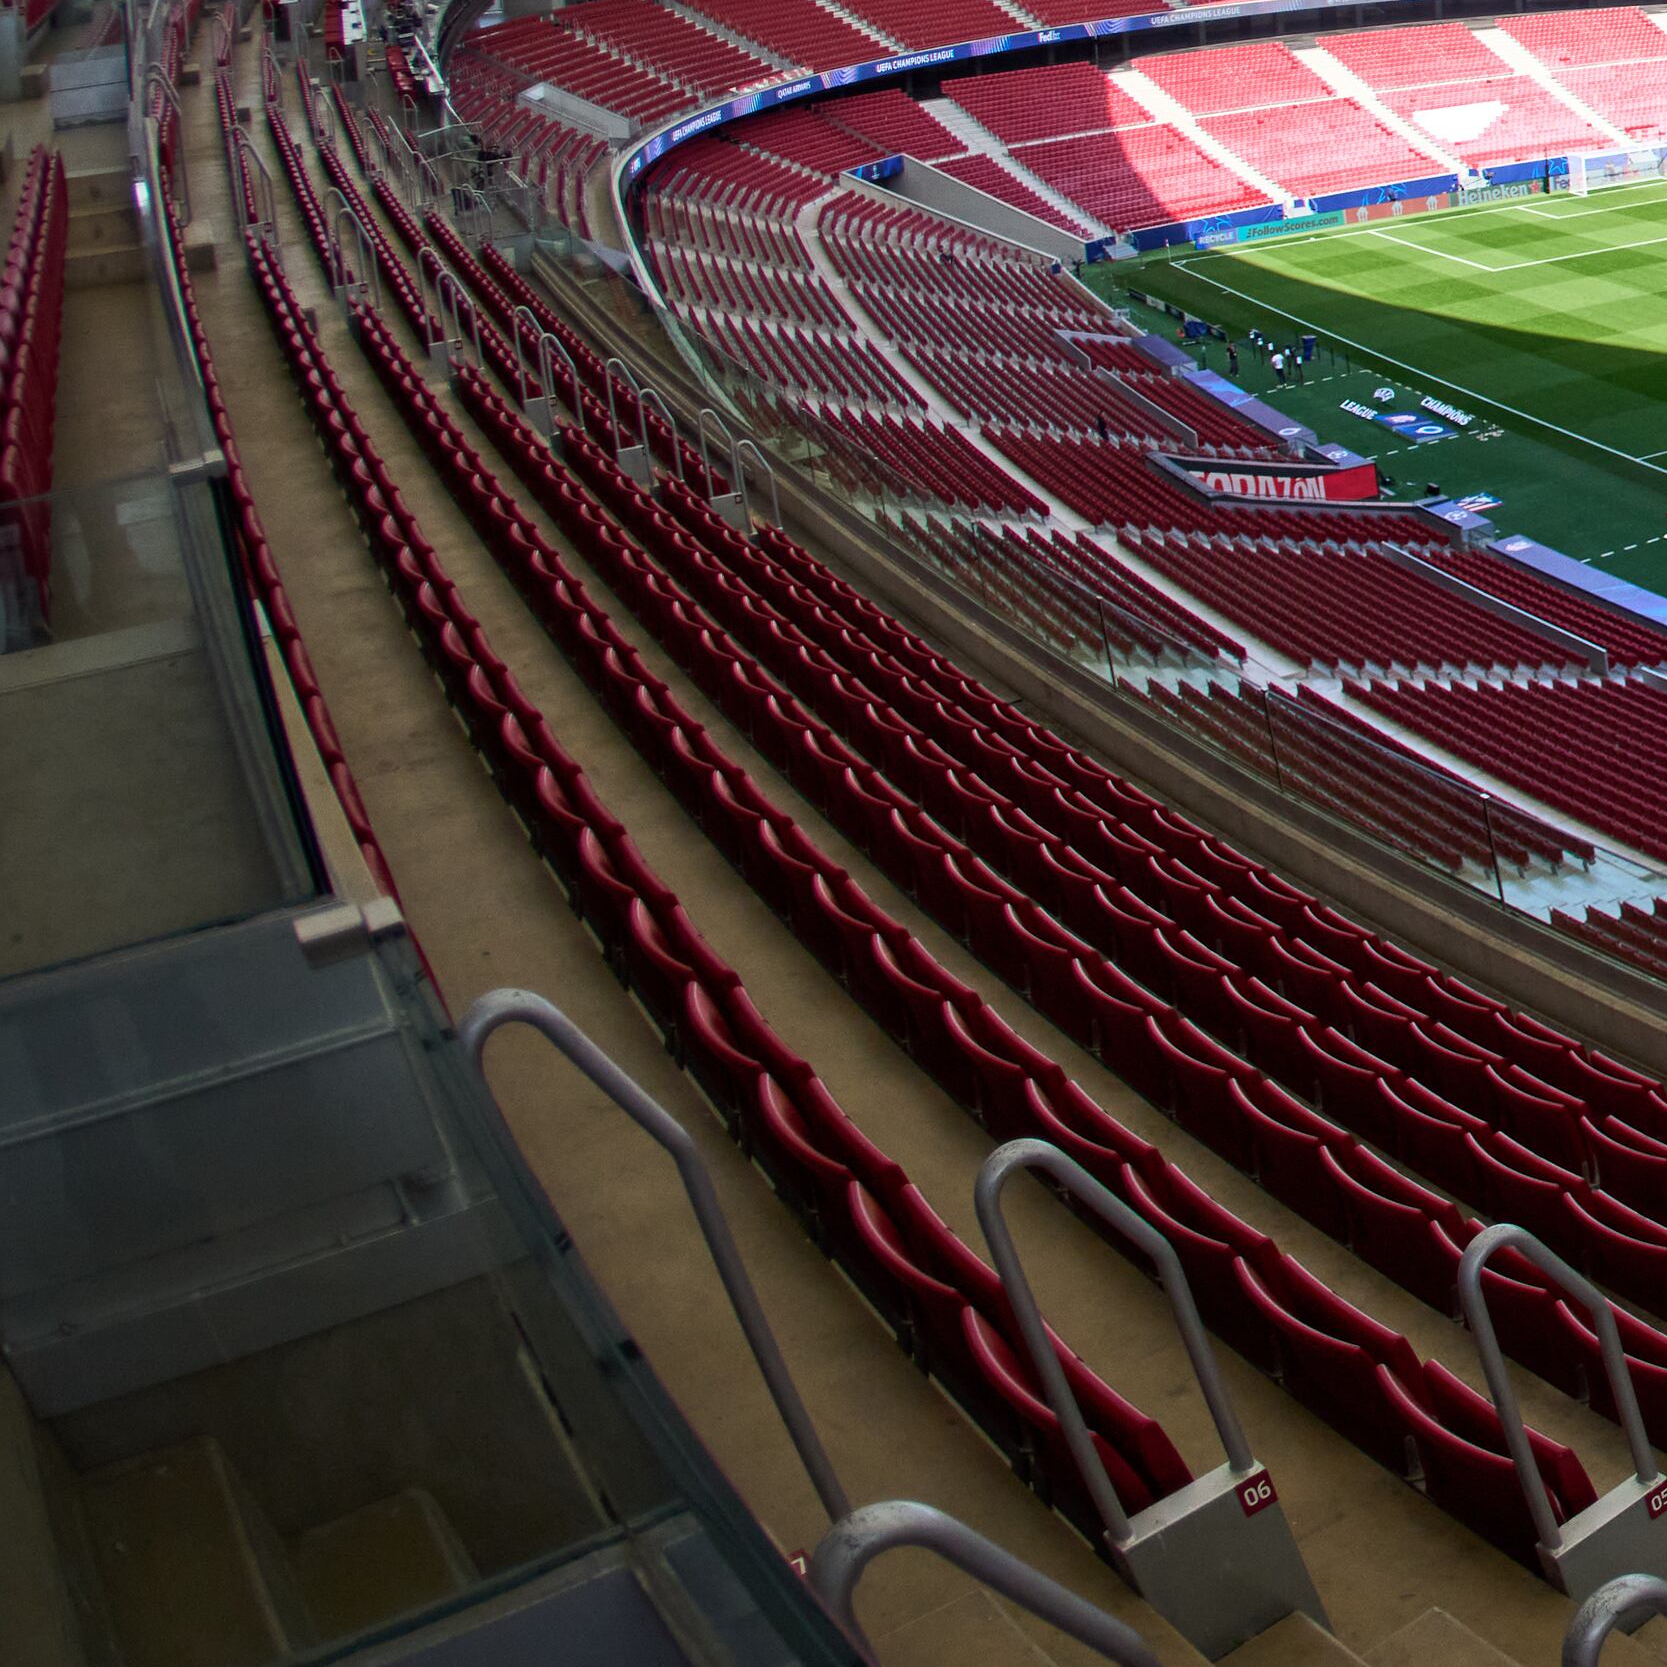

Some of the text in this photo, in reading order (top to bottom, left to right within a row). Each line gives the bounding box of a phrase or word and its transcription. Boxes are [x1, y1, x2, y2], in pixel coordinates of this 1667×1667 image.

[1151, 6, 1241, 25] UEFA CHAMPIONS LEAGUE
[877, 49, 955, 73] UEFA CHAMPIONS LEAGUE
[672, 110, 722, 142] UEFA CHAMPIONS LEAGUE
[1459, 183, 1529, 207] Heineken
[1199, 230, 1235, 245] RECYCLE
[1339, 399, 1379, 421] LEAGUE
[1420, 395, 1473, 427] CHAMPIONS
[1243, 1480, 1272, 1507] 06
